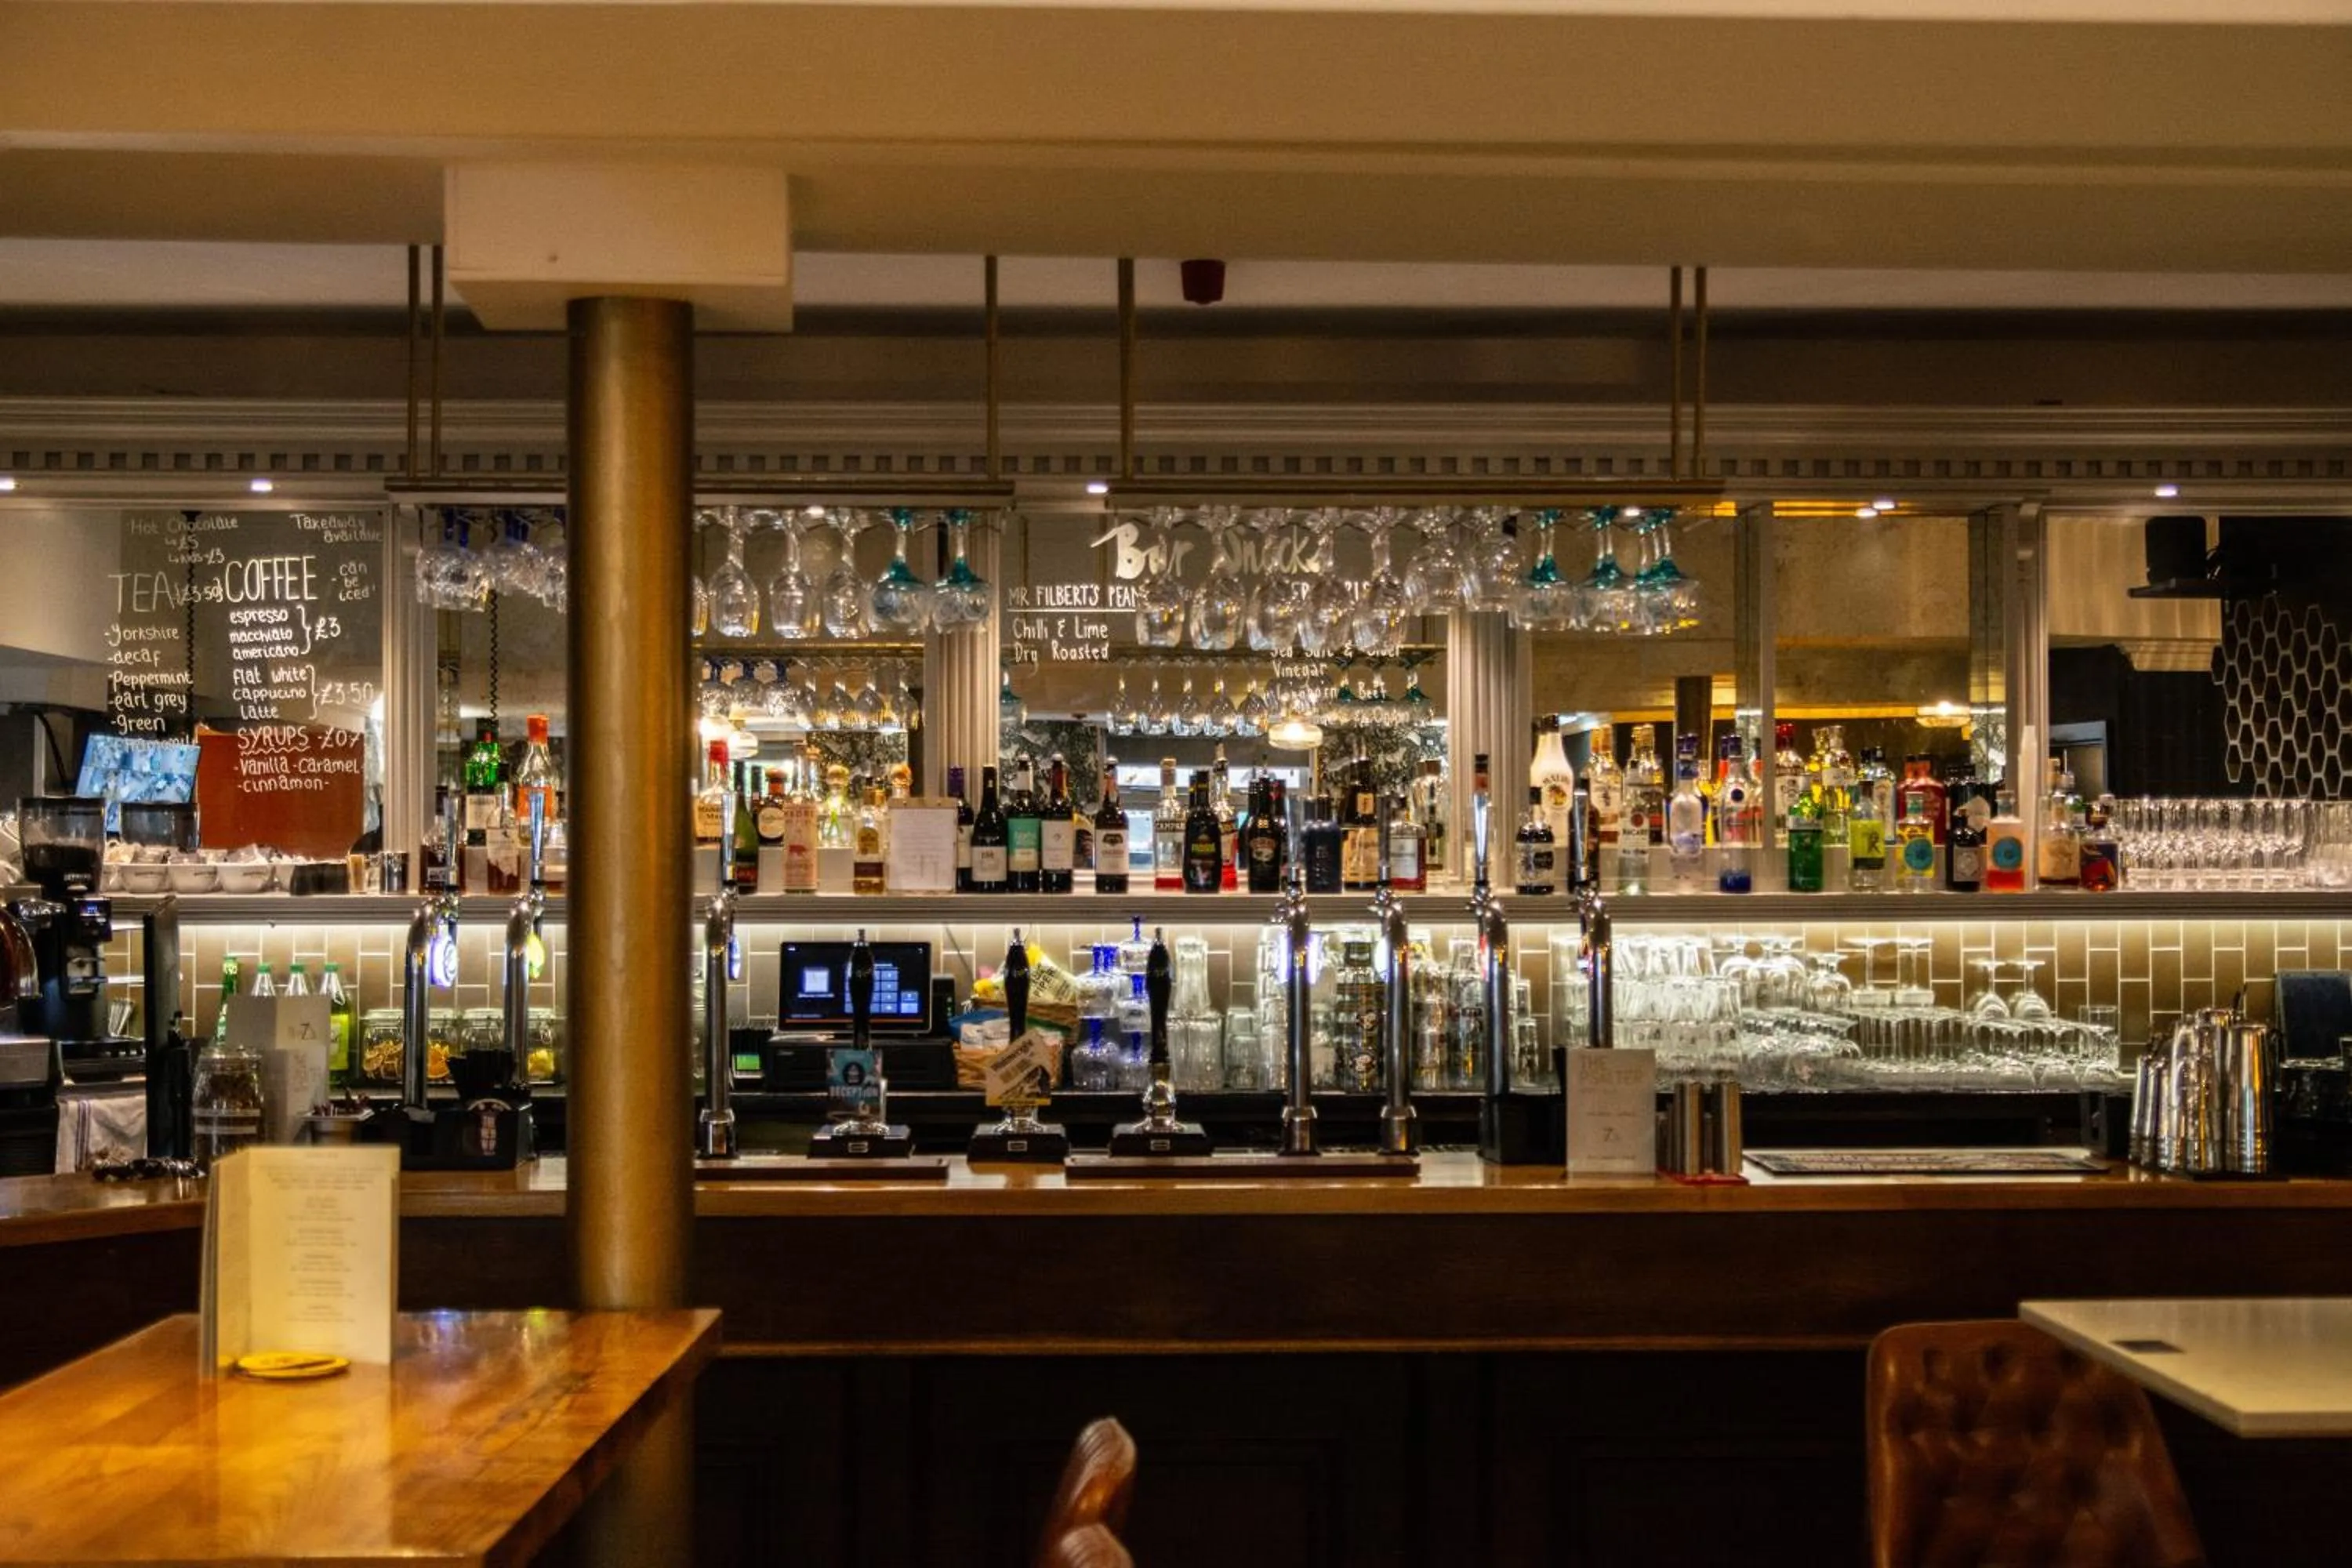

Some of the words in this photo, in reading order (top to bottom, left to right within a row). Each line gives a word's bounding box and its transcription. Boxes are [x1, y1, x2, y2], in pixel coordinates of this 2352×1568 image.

[225, 555, 318, 603] COFFEE
[107, 571, 175, 614] TEA
[1007, 586, 1030, 607] MR
[1036, 583, 1101, 608] FILBERT'S
[230, 608, 289, 626] espresso
[1012, 617, 1049, 640] Chilli
[1074, 615, 1109, 640] Lime
[230, 628, 292, 643] macchiato
[315, 616, 341, 641] £3
[233, 646, 299, 660] americano
[1014, 641, 1040, 677] Dry
[1051, 639, 1110, 662] Roasted
[270, 666, 308, 685] white
[154, 693, 187, 713] grey
[233, 687, 307, 704] cappucino
[240, 704, 280, 721] latte
[238, 725, 310, 750] SYRUPS
